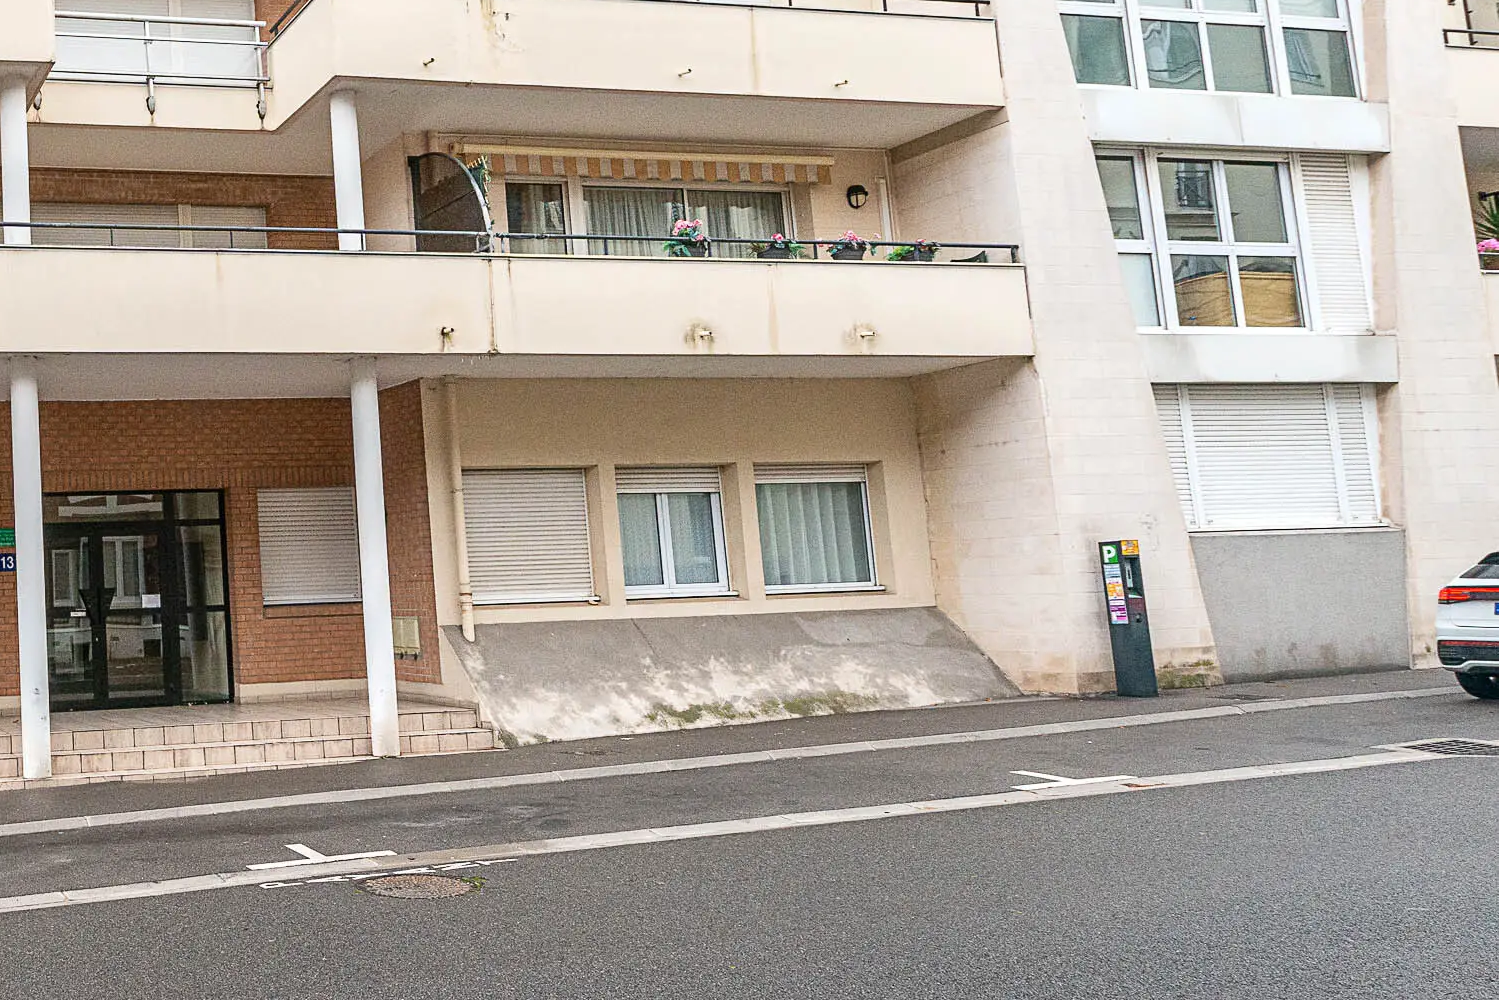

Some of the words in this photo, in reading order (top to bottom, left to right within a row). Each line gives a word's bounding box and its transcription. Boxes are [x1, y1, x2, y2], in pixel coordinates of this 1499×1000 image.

[0, 556, 14, 569] 13
[1102, 545, 1116, 563] P
[259, 858, 517, 889] PAYANT
